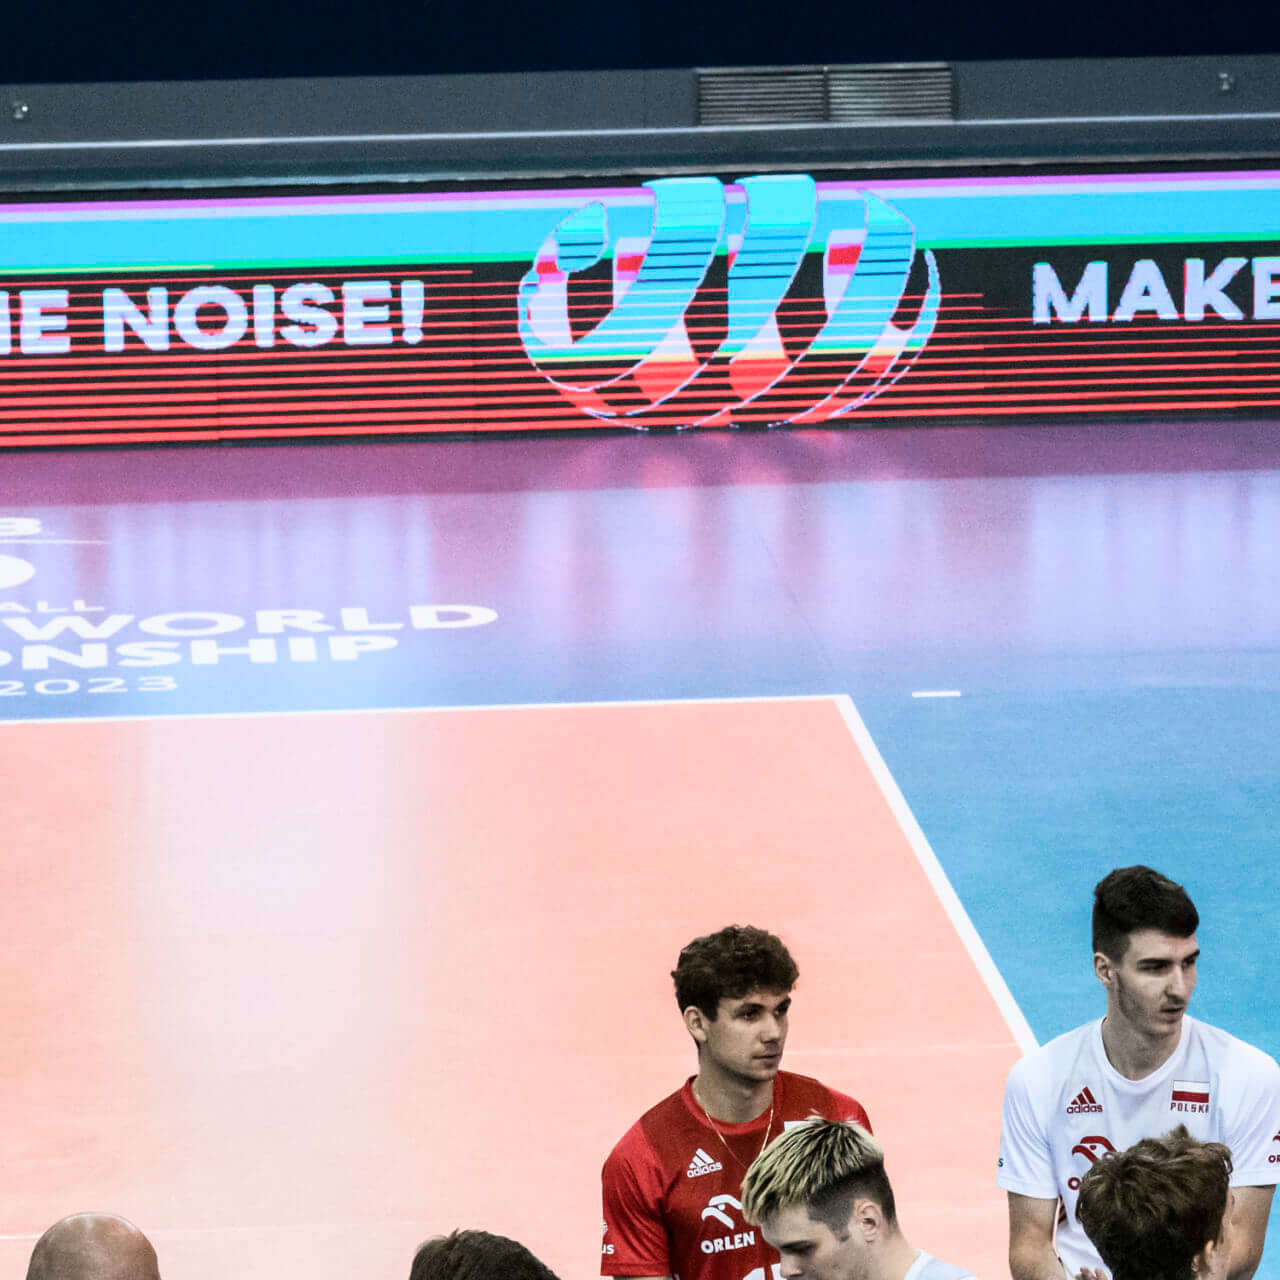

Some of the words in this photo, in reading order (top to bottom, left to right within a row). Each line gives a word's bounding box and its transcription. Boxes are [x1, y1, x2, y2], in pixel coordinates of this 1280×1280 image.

[102, 280, 426, 352] NOISE!
[1, 604, 499, 641] WORLD
[1066, 1104, 1104, 1115] adidas
[686, 1161, 724, 1179] adidas
[700, 1230, 756, 1255] ORLEN
